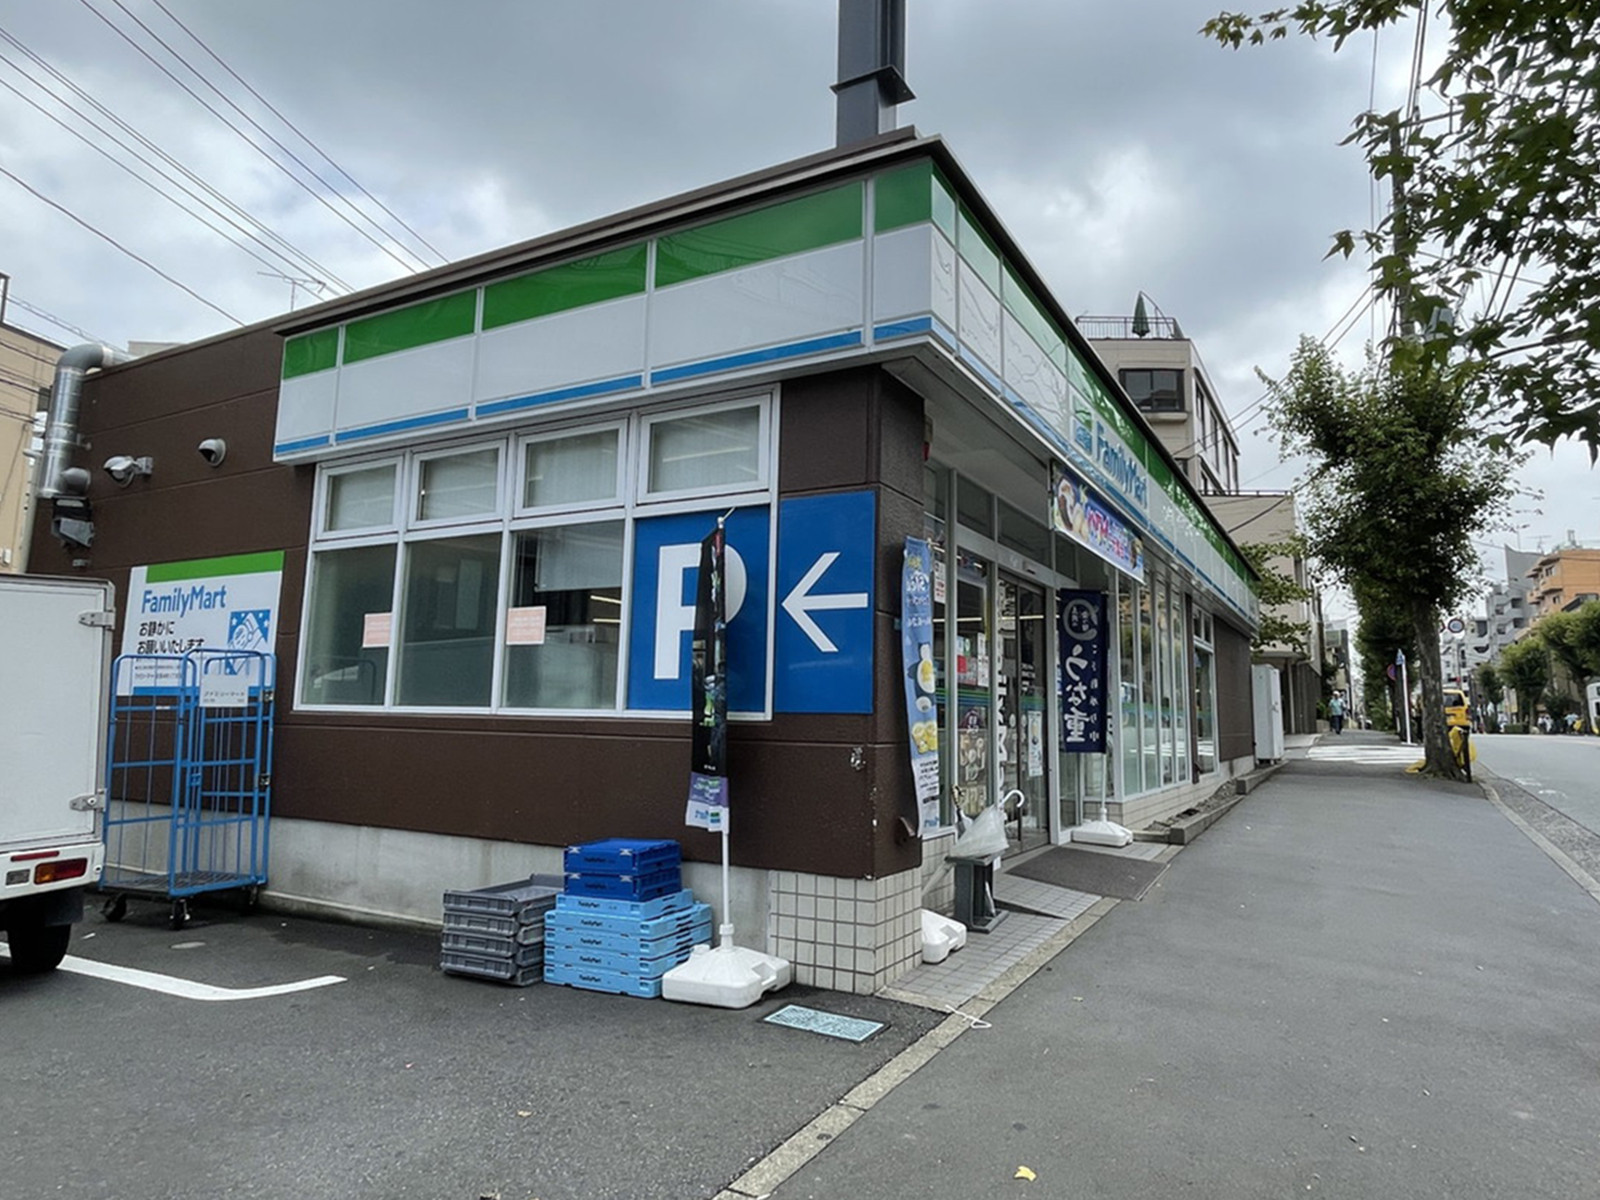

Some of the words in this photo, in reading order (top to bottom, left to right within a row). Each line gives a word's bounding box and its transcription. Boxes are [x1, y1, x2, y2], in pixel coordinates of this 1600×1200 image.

[1097, 421, 1147, 509] FamilyMart
[139, 621, 175, 637] お静かに
[141, 585, 226, 618] FamilyMart
[654, 543, 747, 679] P
[1064, 644, 1089, 742] うな重
